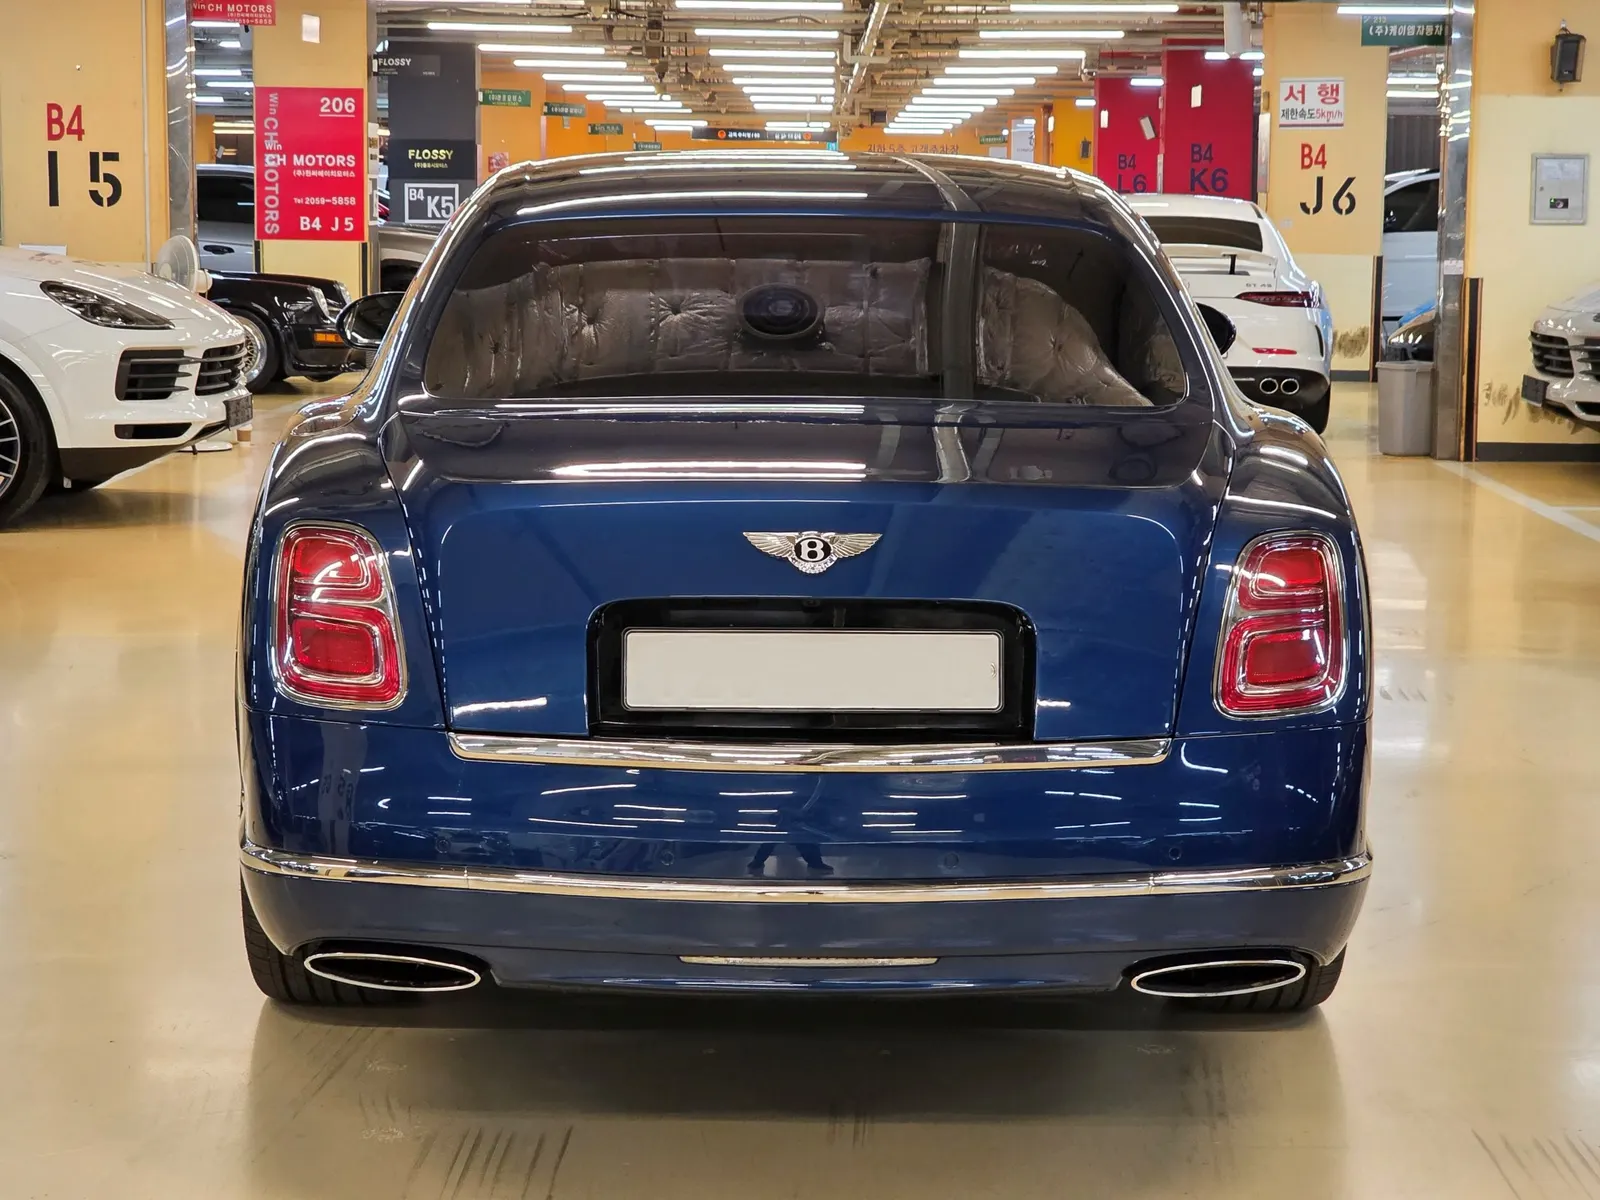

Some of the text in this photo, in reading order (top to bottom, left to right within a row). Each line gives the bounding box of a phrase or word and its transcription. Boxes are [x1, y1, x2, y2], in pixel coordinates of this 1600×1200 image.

[207, 4, 223, 12] CH
[227, 5, 273, 13] MOTORS
[378, 58, 412, 66] FLOSSY
[320, 97, 356, 113] 206
[46, 103, 85, 141] B4
[293, 154, 356, 167] MOTORS
[408, 149, 454, 160] FLOSSY
[1118, 153, 1136, 170] B4
[1190, 143, 1214, 163] B4
[1301, 143, 1327, 170] B4
[1117, 174, 1148, 194] L6
[1189, 168, 1229, 193] K6
[305, 197, 356, 205] 2059-5858
[409, 188, 425, 201] B4
[1299, 175, 1357, 216] J6
[427, 195, 455, 219] K5
[300, 216, 322, 231] B4
[800, 540, 825, 562] B
